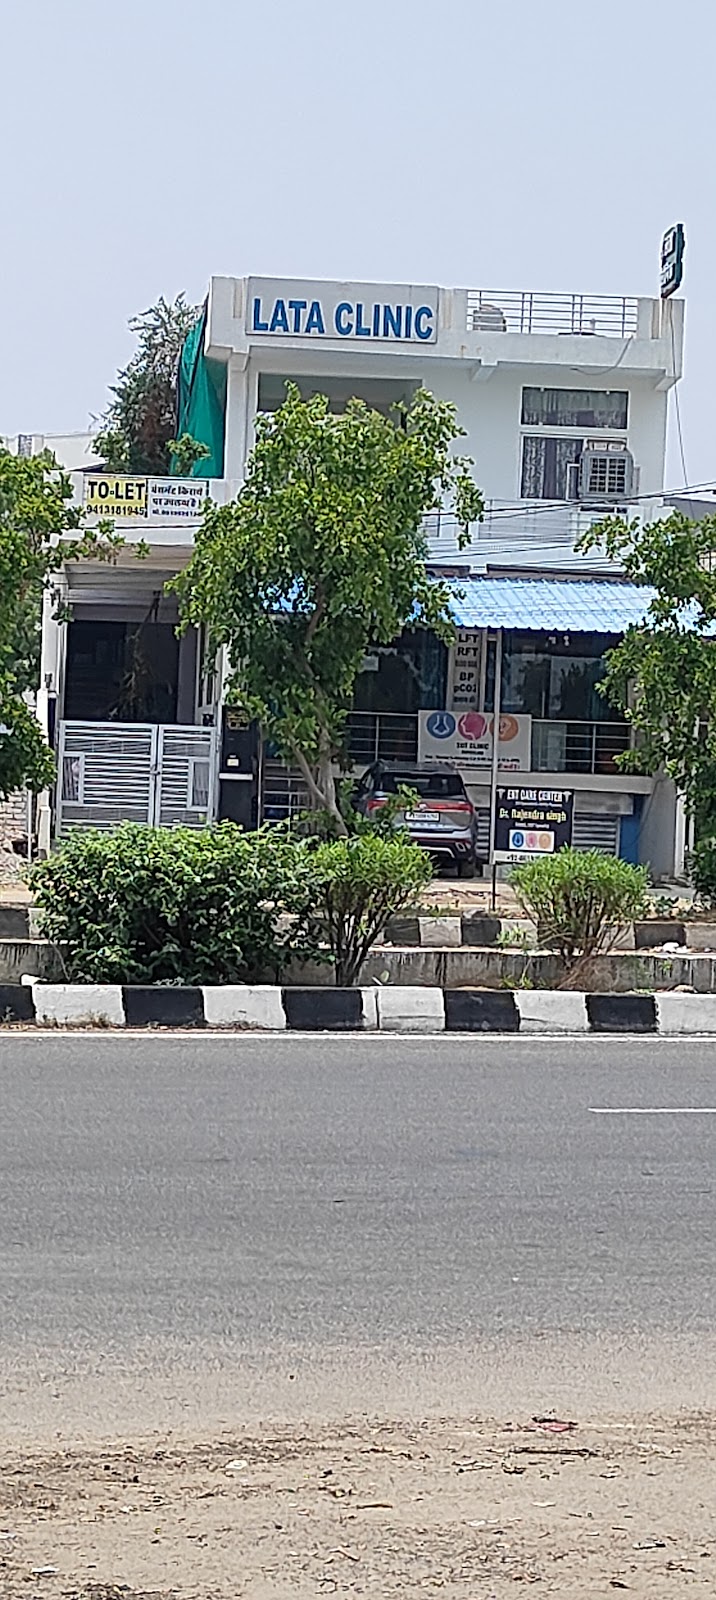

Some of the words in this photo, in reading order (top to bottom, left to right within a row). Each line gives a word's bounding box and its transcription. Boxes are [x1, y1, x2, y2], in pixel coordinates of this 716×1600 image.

[253, 298, 325, 334] LATA
[335, 302, 433, 340] CLINIC
[88, 480, 145, 500] TO-LET
[458, 633, 479, 643] LFT
[457, 647, 479, 657] RFT
